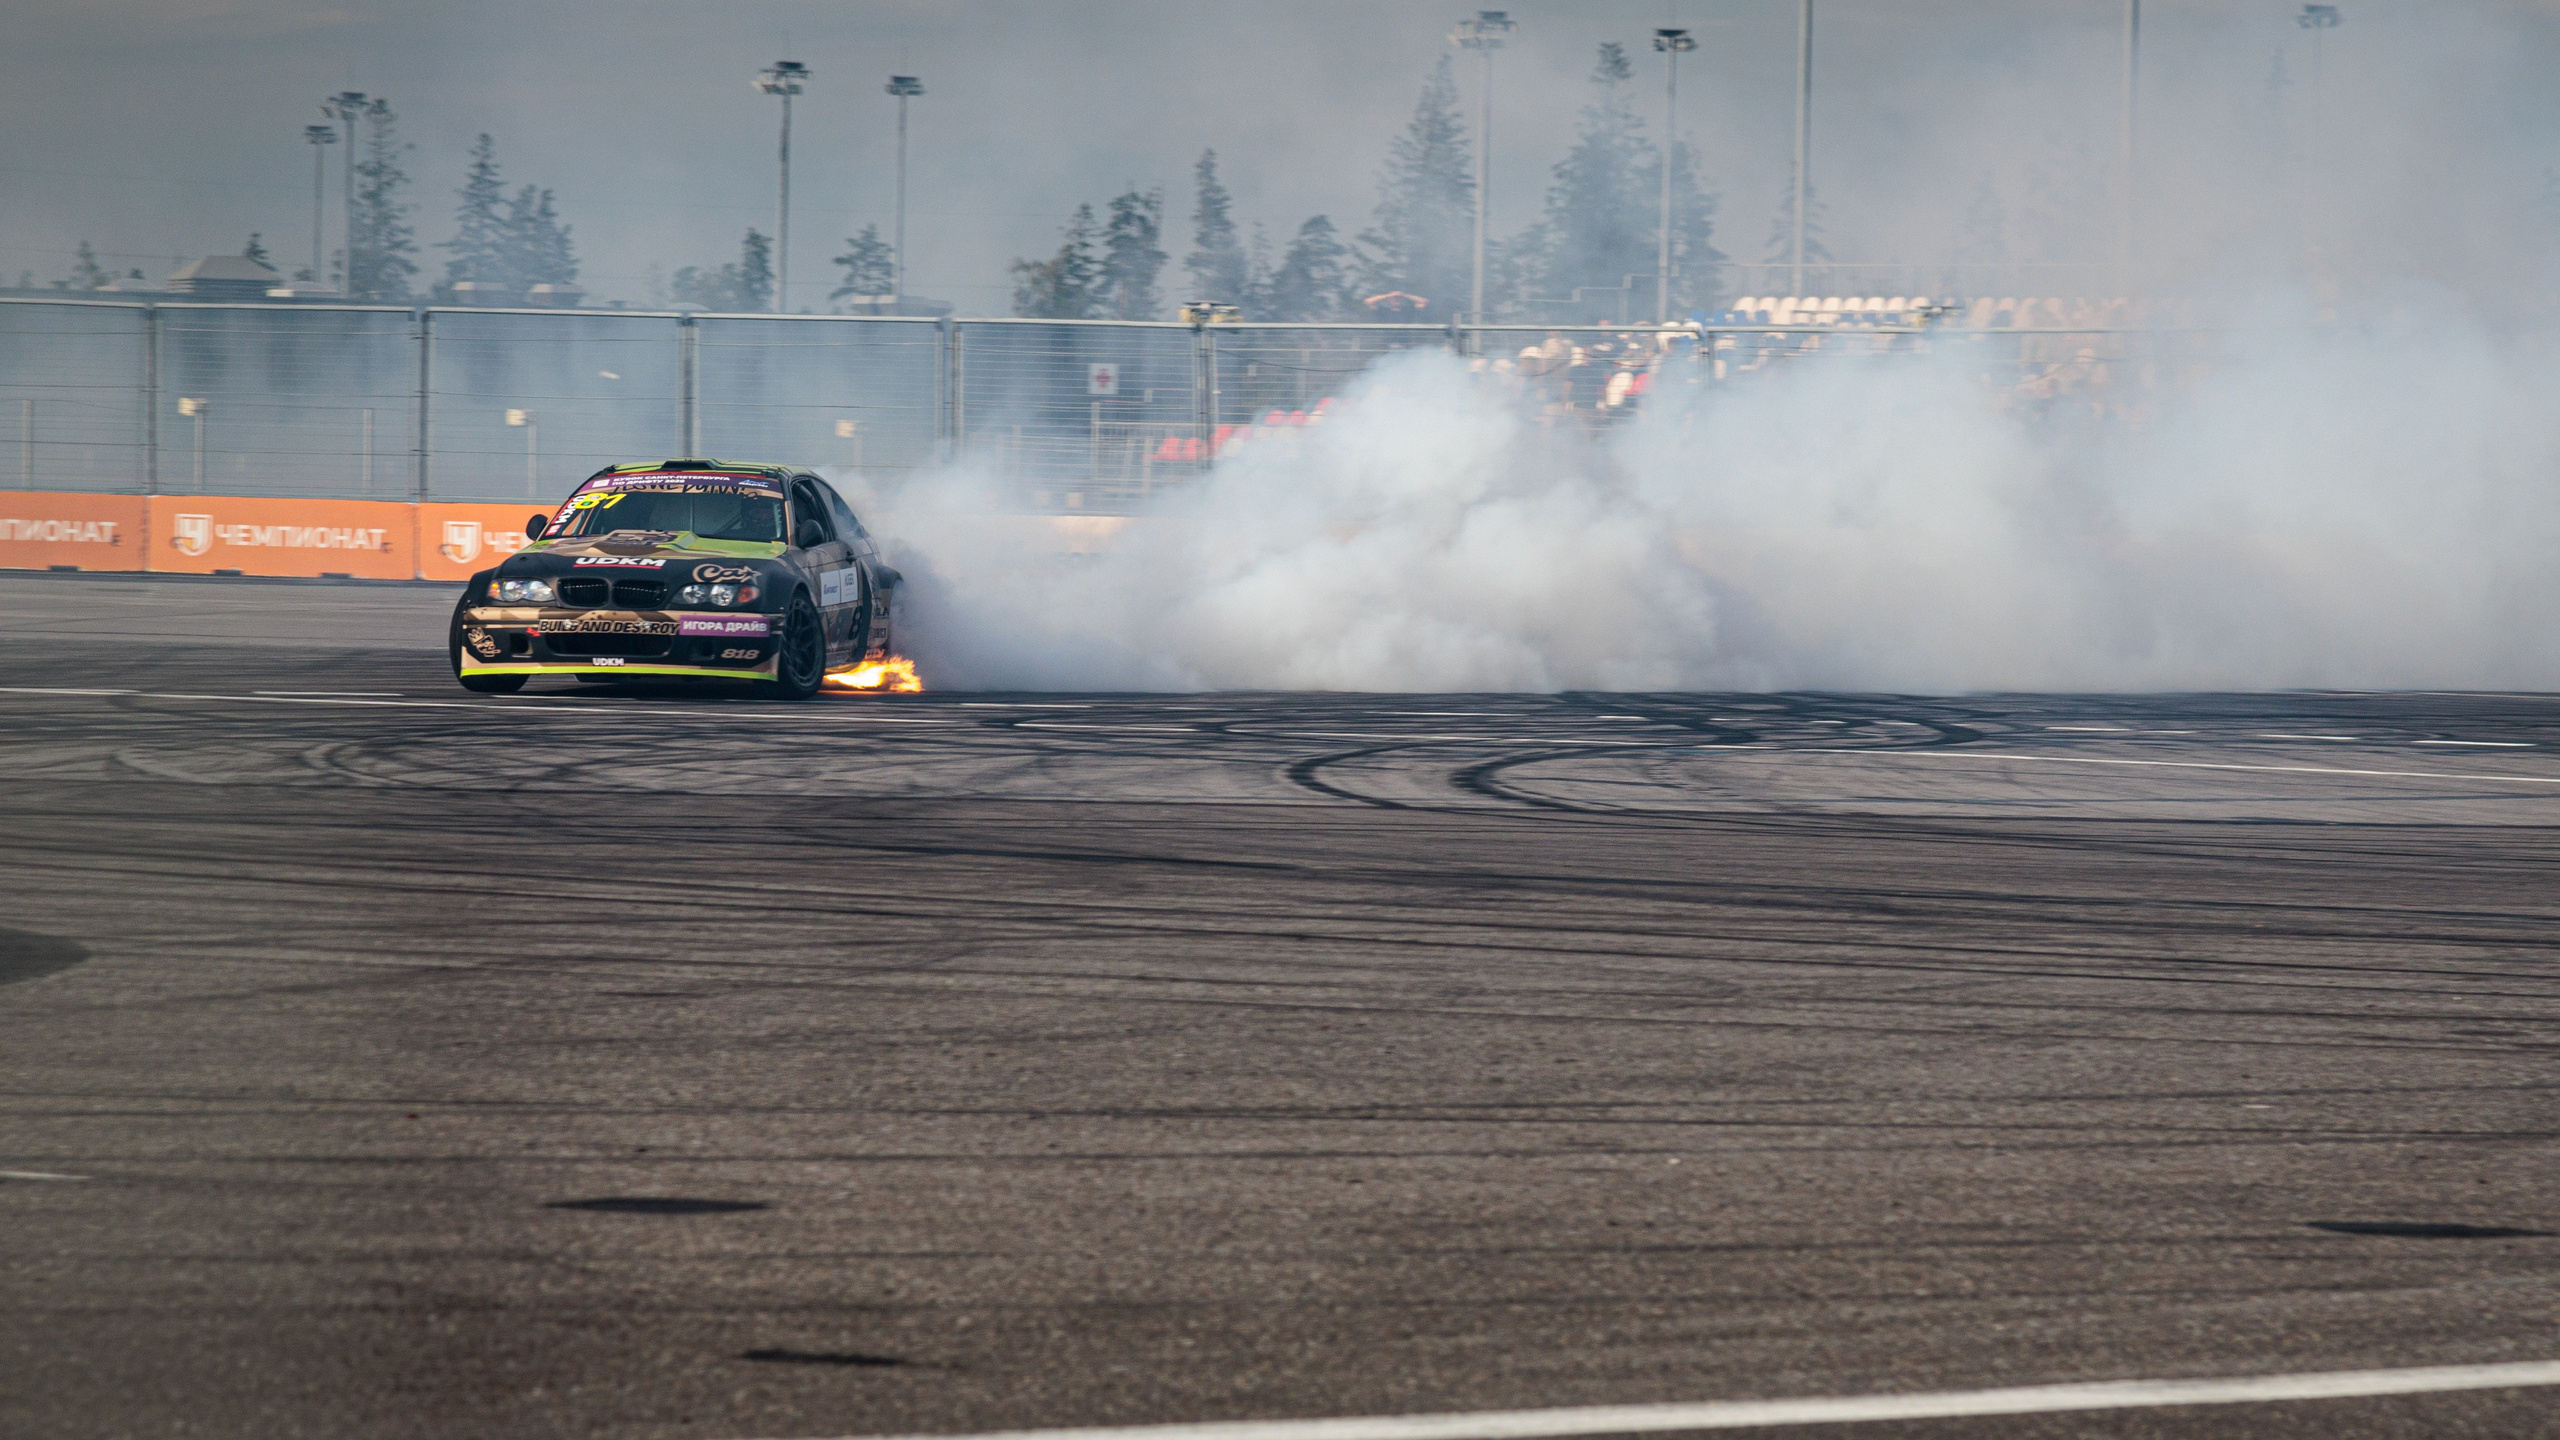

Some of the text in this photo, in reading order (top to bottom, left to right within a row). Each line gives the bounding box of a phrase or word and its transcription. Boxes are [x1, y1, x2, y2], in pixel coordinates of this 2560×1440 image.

[574, 493, 627, 509] 81
[0, 519, 118, 542] ПИОНАТ
[215, 524, 388, 550] ЧЕМПИОНАТ
[575, 557, 667, 567] UDKM
[580, 621, 612, 633] AND
[683, 620, 767, 632] ИГОРА ДРАЙВ
[592, 657, 625, 666] UDKM
